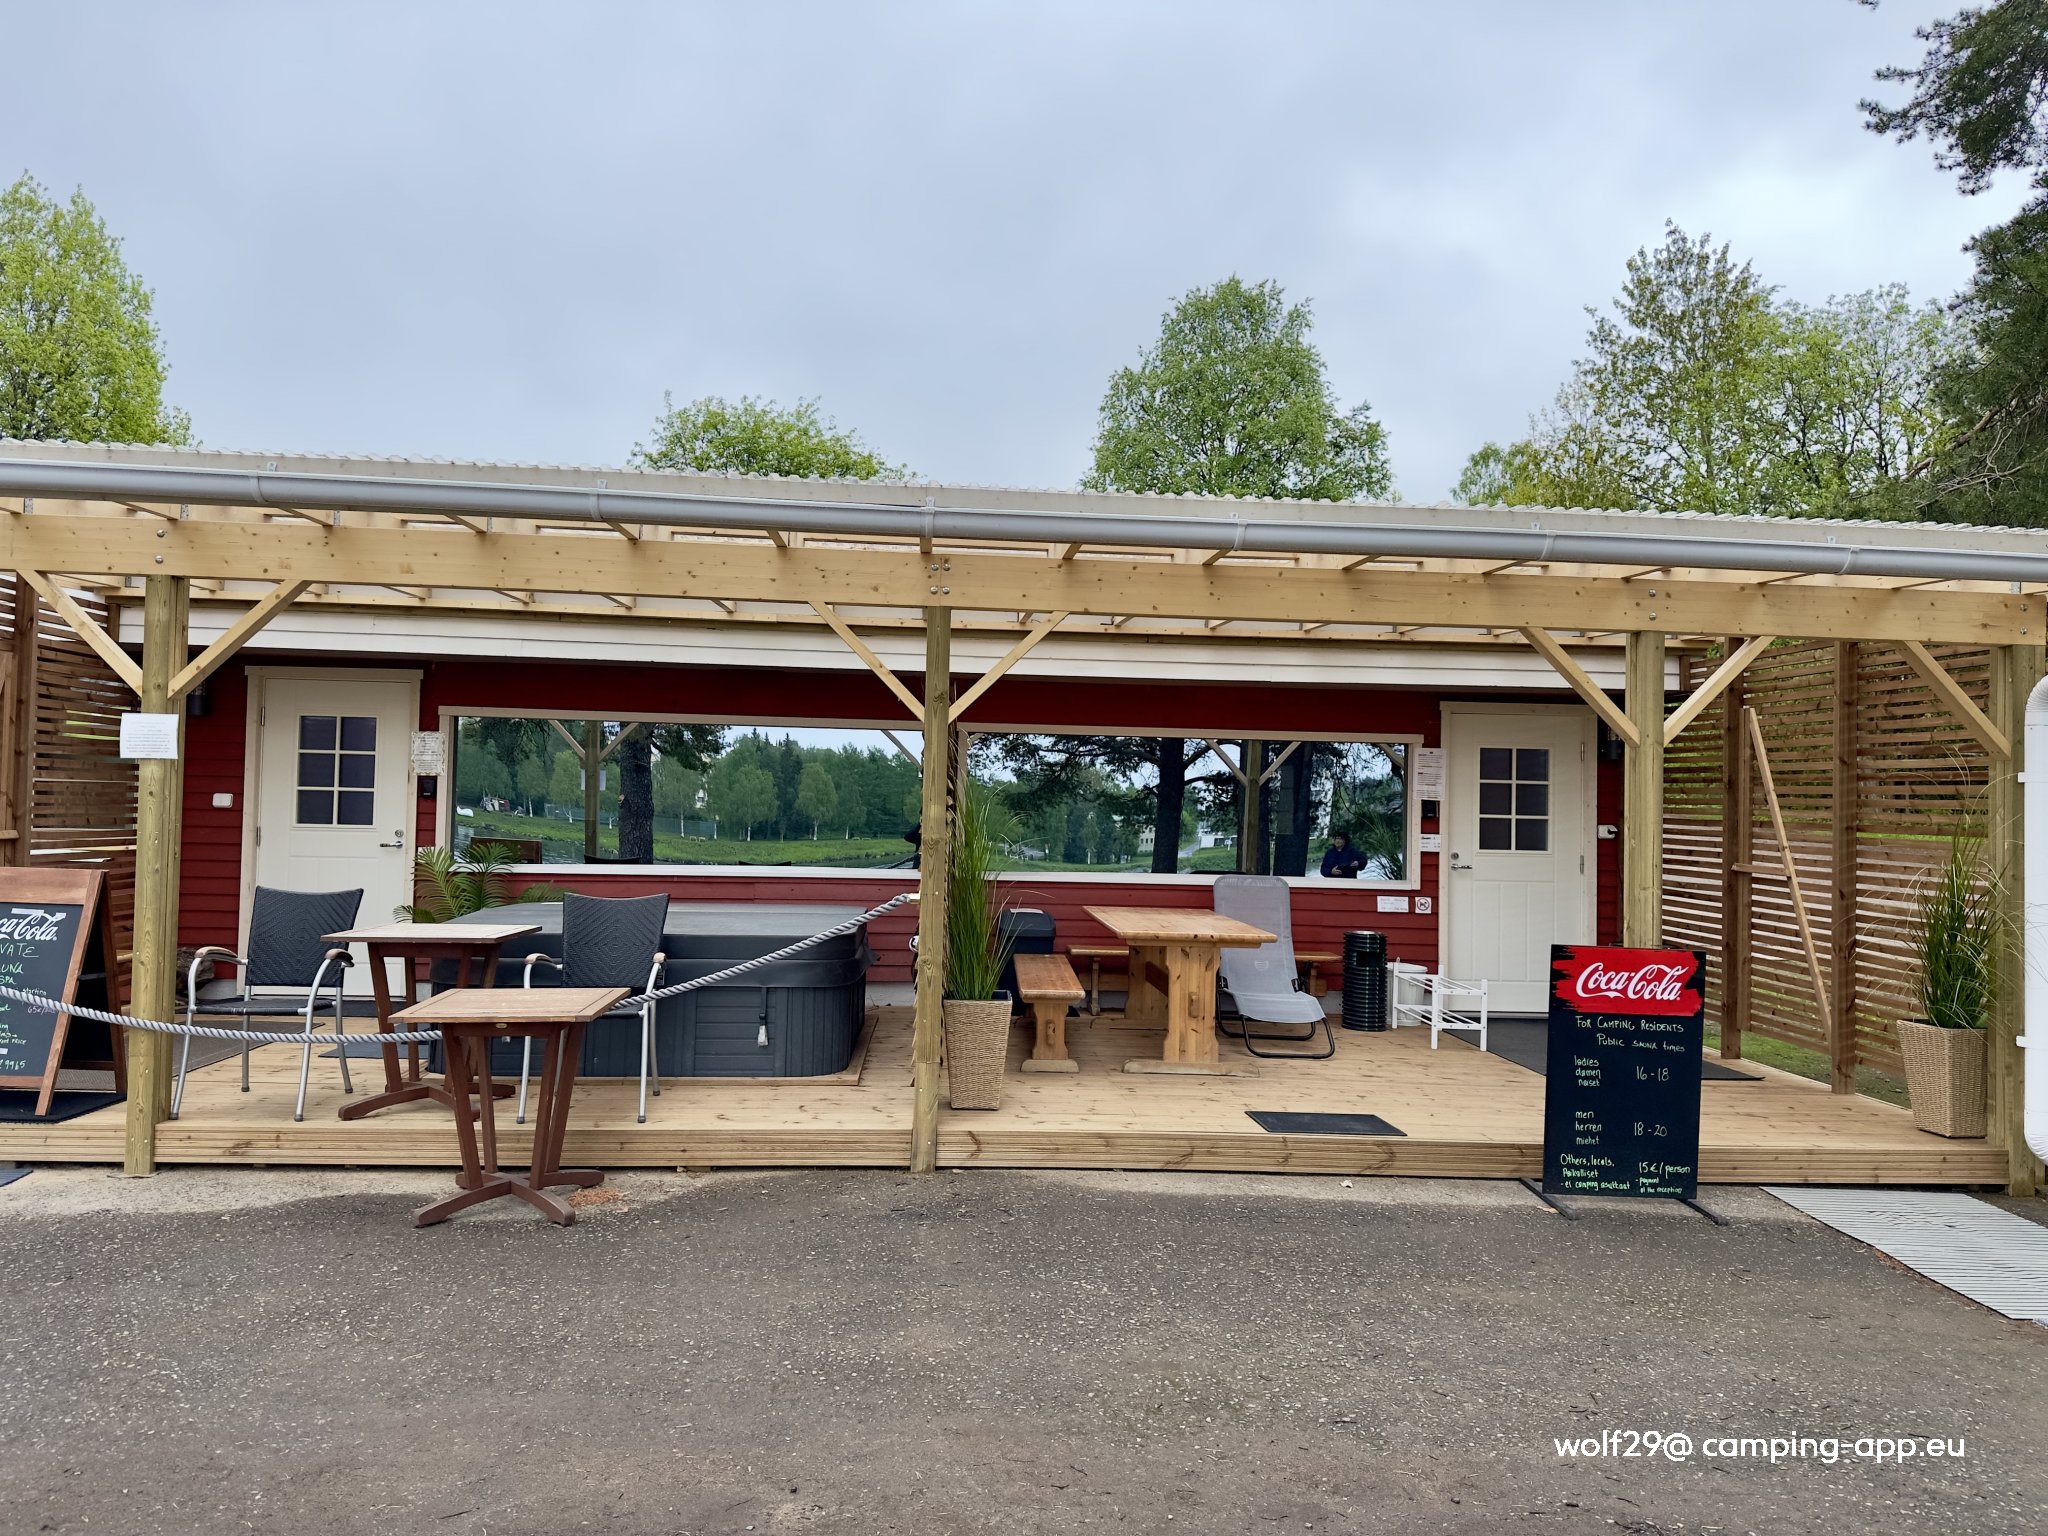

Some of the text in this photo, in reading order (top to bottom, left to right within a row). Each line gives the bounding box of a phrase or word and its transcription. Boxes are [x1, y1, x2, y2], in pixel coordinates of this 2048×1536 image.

[1576, 962, 1689, 1000] Coca-Cola
[1663, 1041, 1685, 1052] times
[1575, 1111, 1594, 1119] men
[1575, 1121, 1602, 1132] herren
